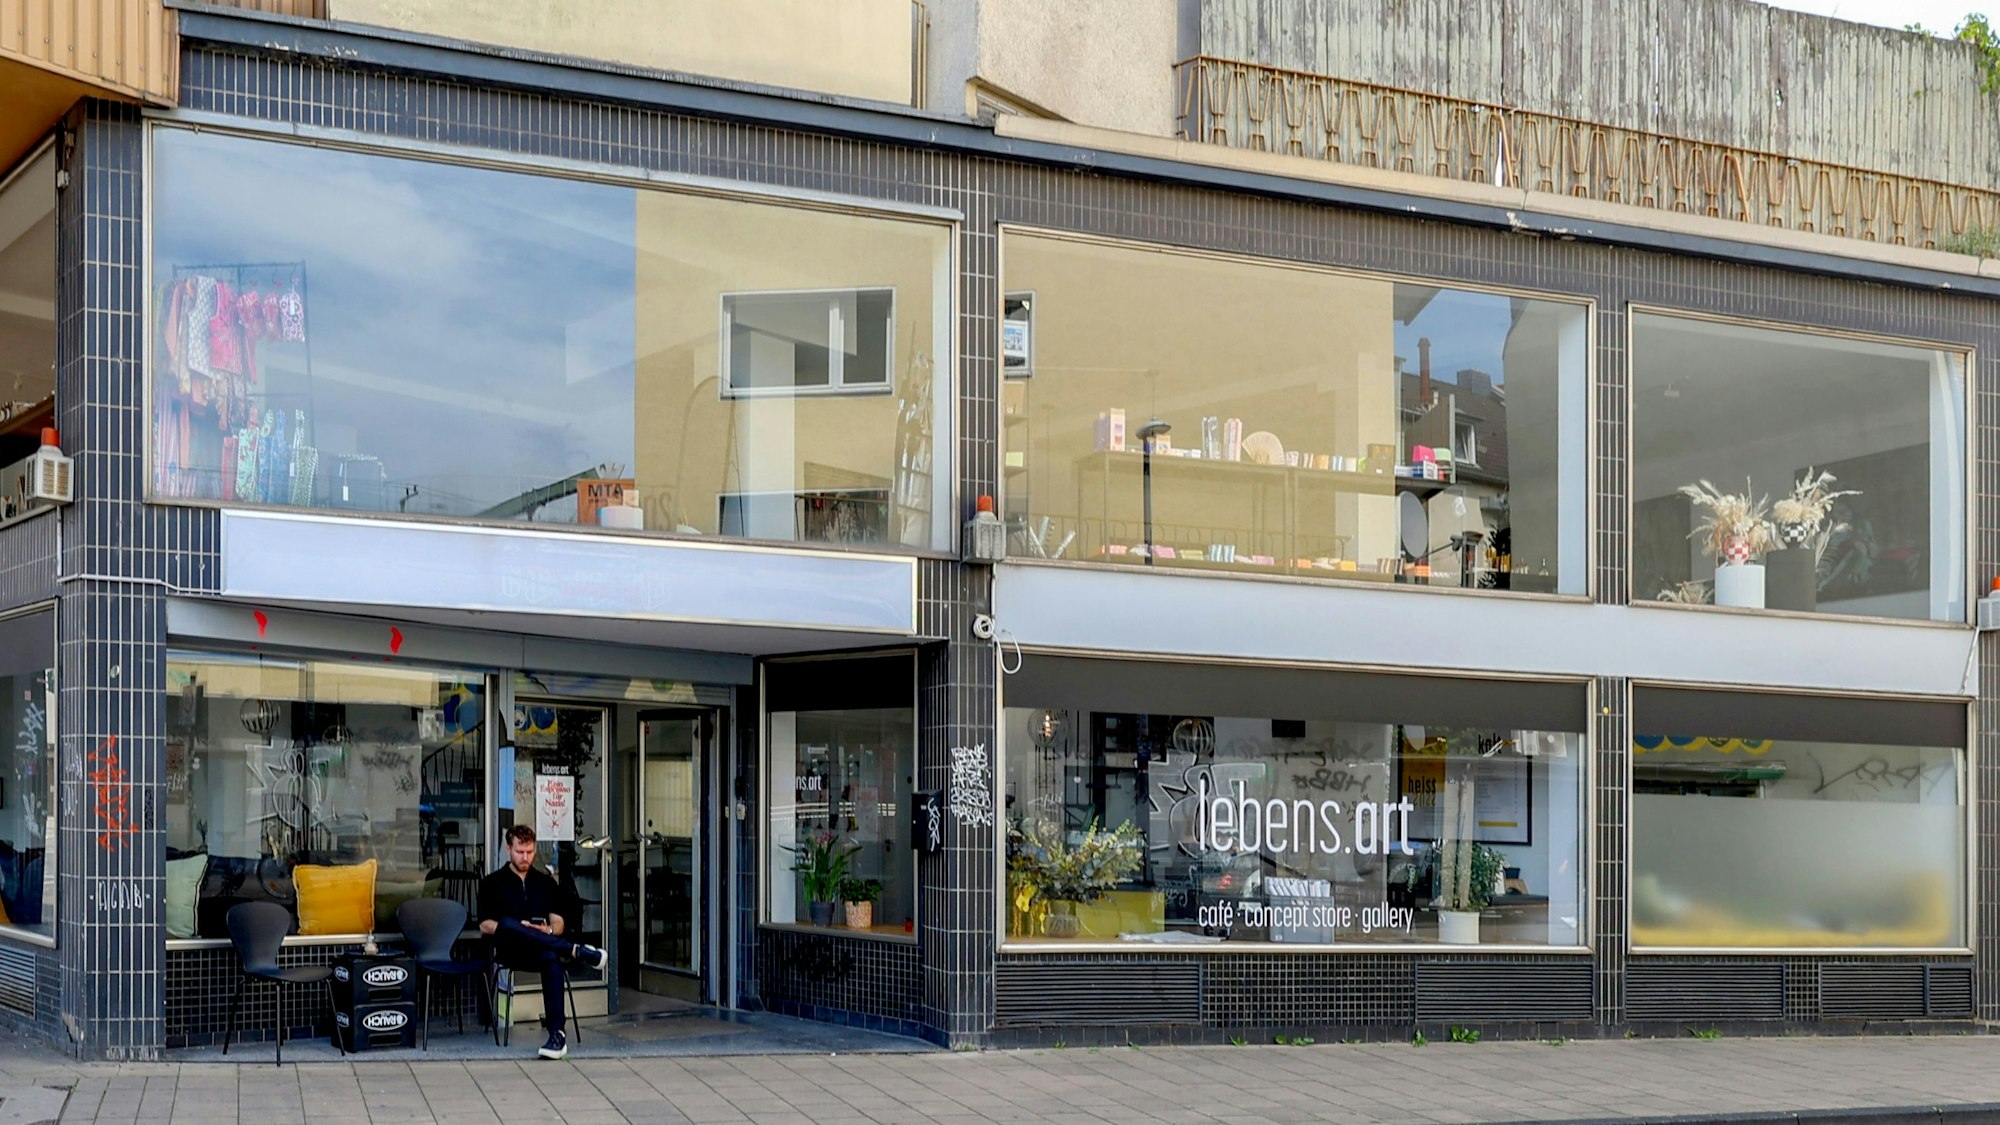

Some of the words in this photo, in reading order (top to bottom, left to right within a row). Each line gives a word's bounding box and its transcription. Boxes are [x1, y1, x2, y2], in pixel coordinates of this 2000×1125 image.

[795, 773, 823, 791] ns.art
[1408, 775, 1437, 794] heiss
[1200, 779, 1415, 856] lebens.art
[1198, 900, 1234, 929] café
[1244, 901, 1310, 933] concept
[1312, 904, 1352, 929] store
[1361, 900, 1414, 934] gallery
[368, 970, 396, 982] RAUCH
[368, 1015, 396, 1027] RAUCH
